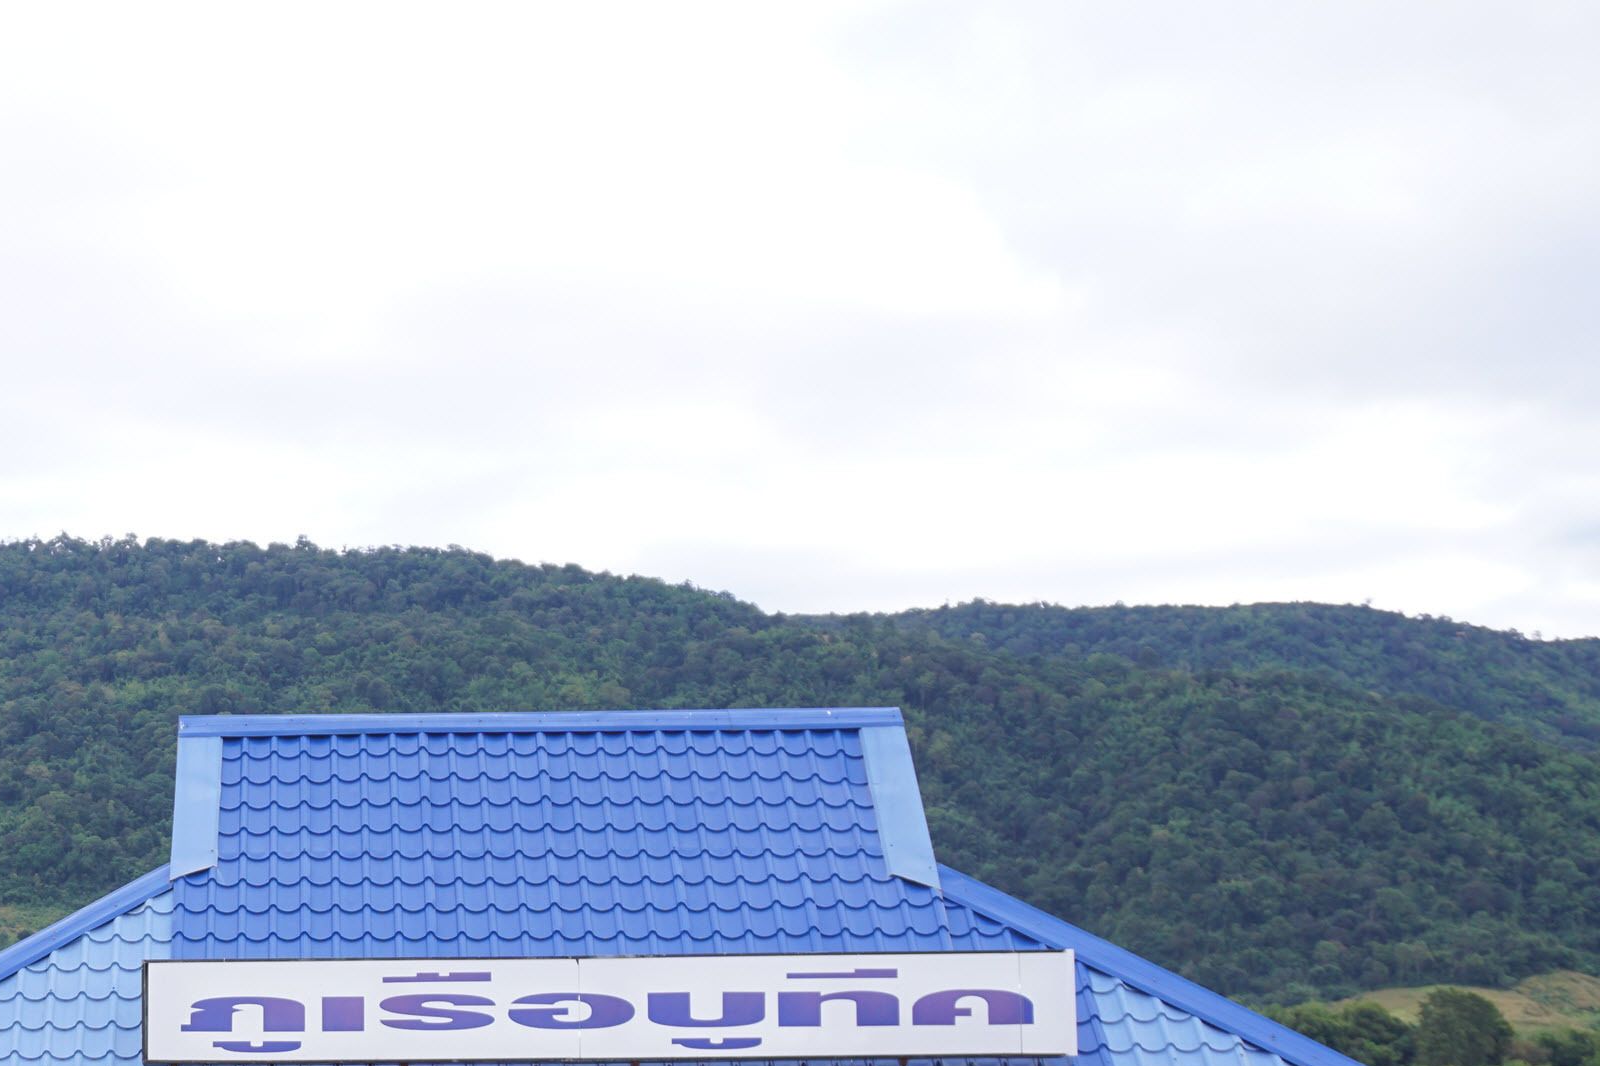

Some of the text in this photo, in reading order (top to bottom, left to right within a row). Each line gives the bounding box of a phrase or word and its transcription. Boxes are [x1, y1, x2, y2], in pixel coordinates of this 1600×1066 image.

[180, 968, 1035, 1054] ภูเรือบูทีค
